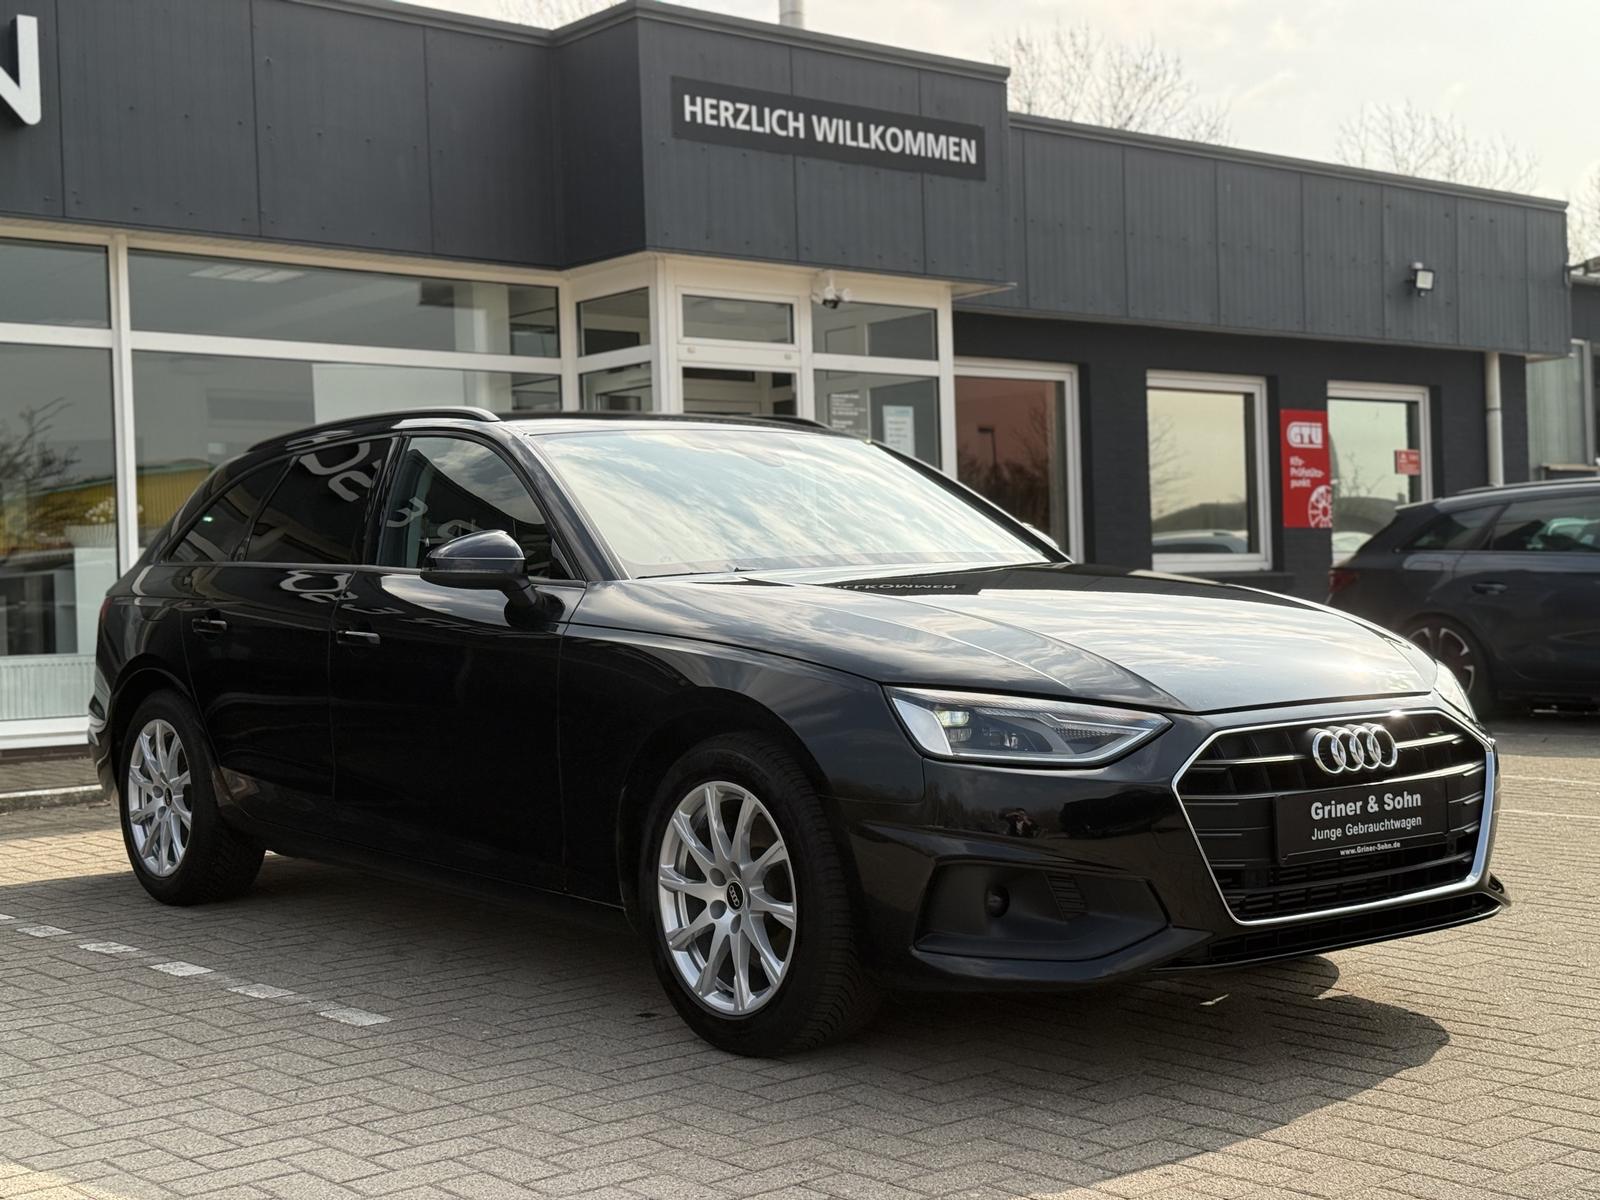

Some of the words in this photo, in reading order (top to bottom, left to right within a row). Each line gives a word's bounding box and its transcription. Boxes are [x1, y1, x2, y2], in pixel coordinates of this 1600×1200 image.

[683, 94, 805, 139] HERZLICH
[811, 114, 977, 165] WILLKOMMEN
[1310, 800, 1363, 820] Griner
[1367, 795, 1379, 813] &
[1383, 791, 1422, 811] Sohn
[1311, 828, 1342, 841] Junge
[1345, 816, 1422, 836] Gebrauchtwagen
[1340, 841, 1401, 856] www.Griner-Sohn.de
